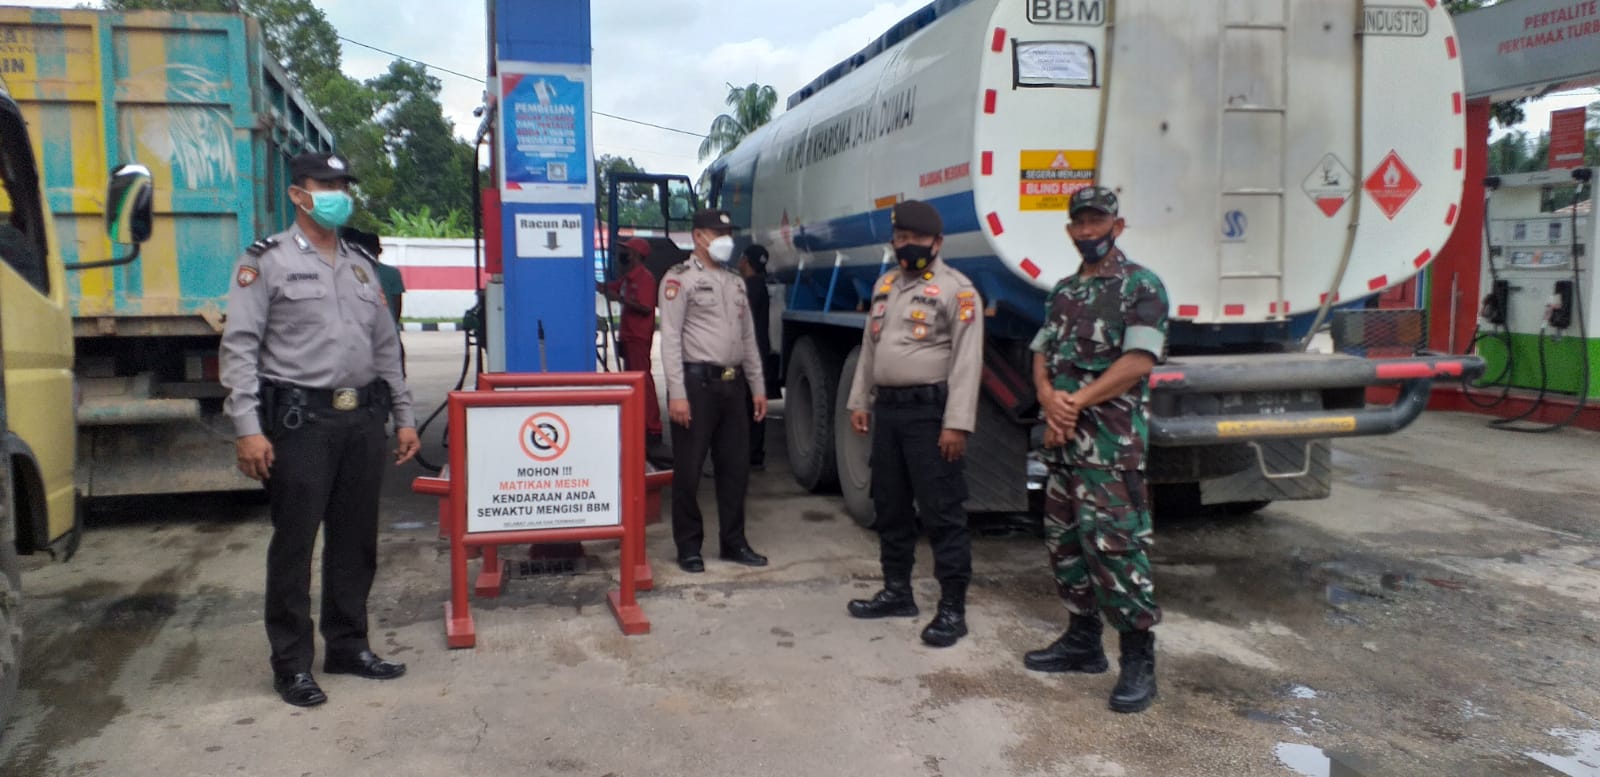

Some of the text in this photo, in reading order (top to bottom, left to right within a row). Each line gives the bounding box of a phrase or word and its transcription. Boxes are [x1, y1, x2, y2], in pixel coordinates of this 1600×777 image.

[1032, 0, 1099, 21] BBM
[1524, 1, 1597, 31] PERTALITE
[1498, 18, 1600, 55] PERTAMAX TURB
[514, 103, 575, 115] PEMBELIAN
[880, 85, 917, 137] DUMAI
[1025, 170, 1056, 179] SEGERA
[1026, 183, 1060, 195] BLIND
[520, 219, 581, 230] Racun Api
[517, 466, 573, 477] MOHON !!!
[500, 479, 590, 491] MATIKAN MESIN
[493, 491, 596, 504] KENDARAAN ANDA
[477, 502, 610, 517] SEWAKTU MENGISI BBM
